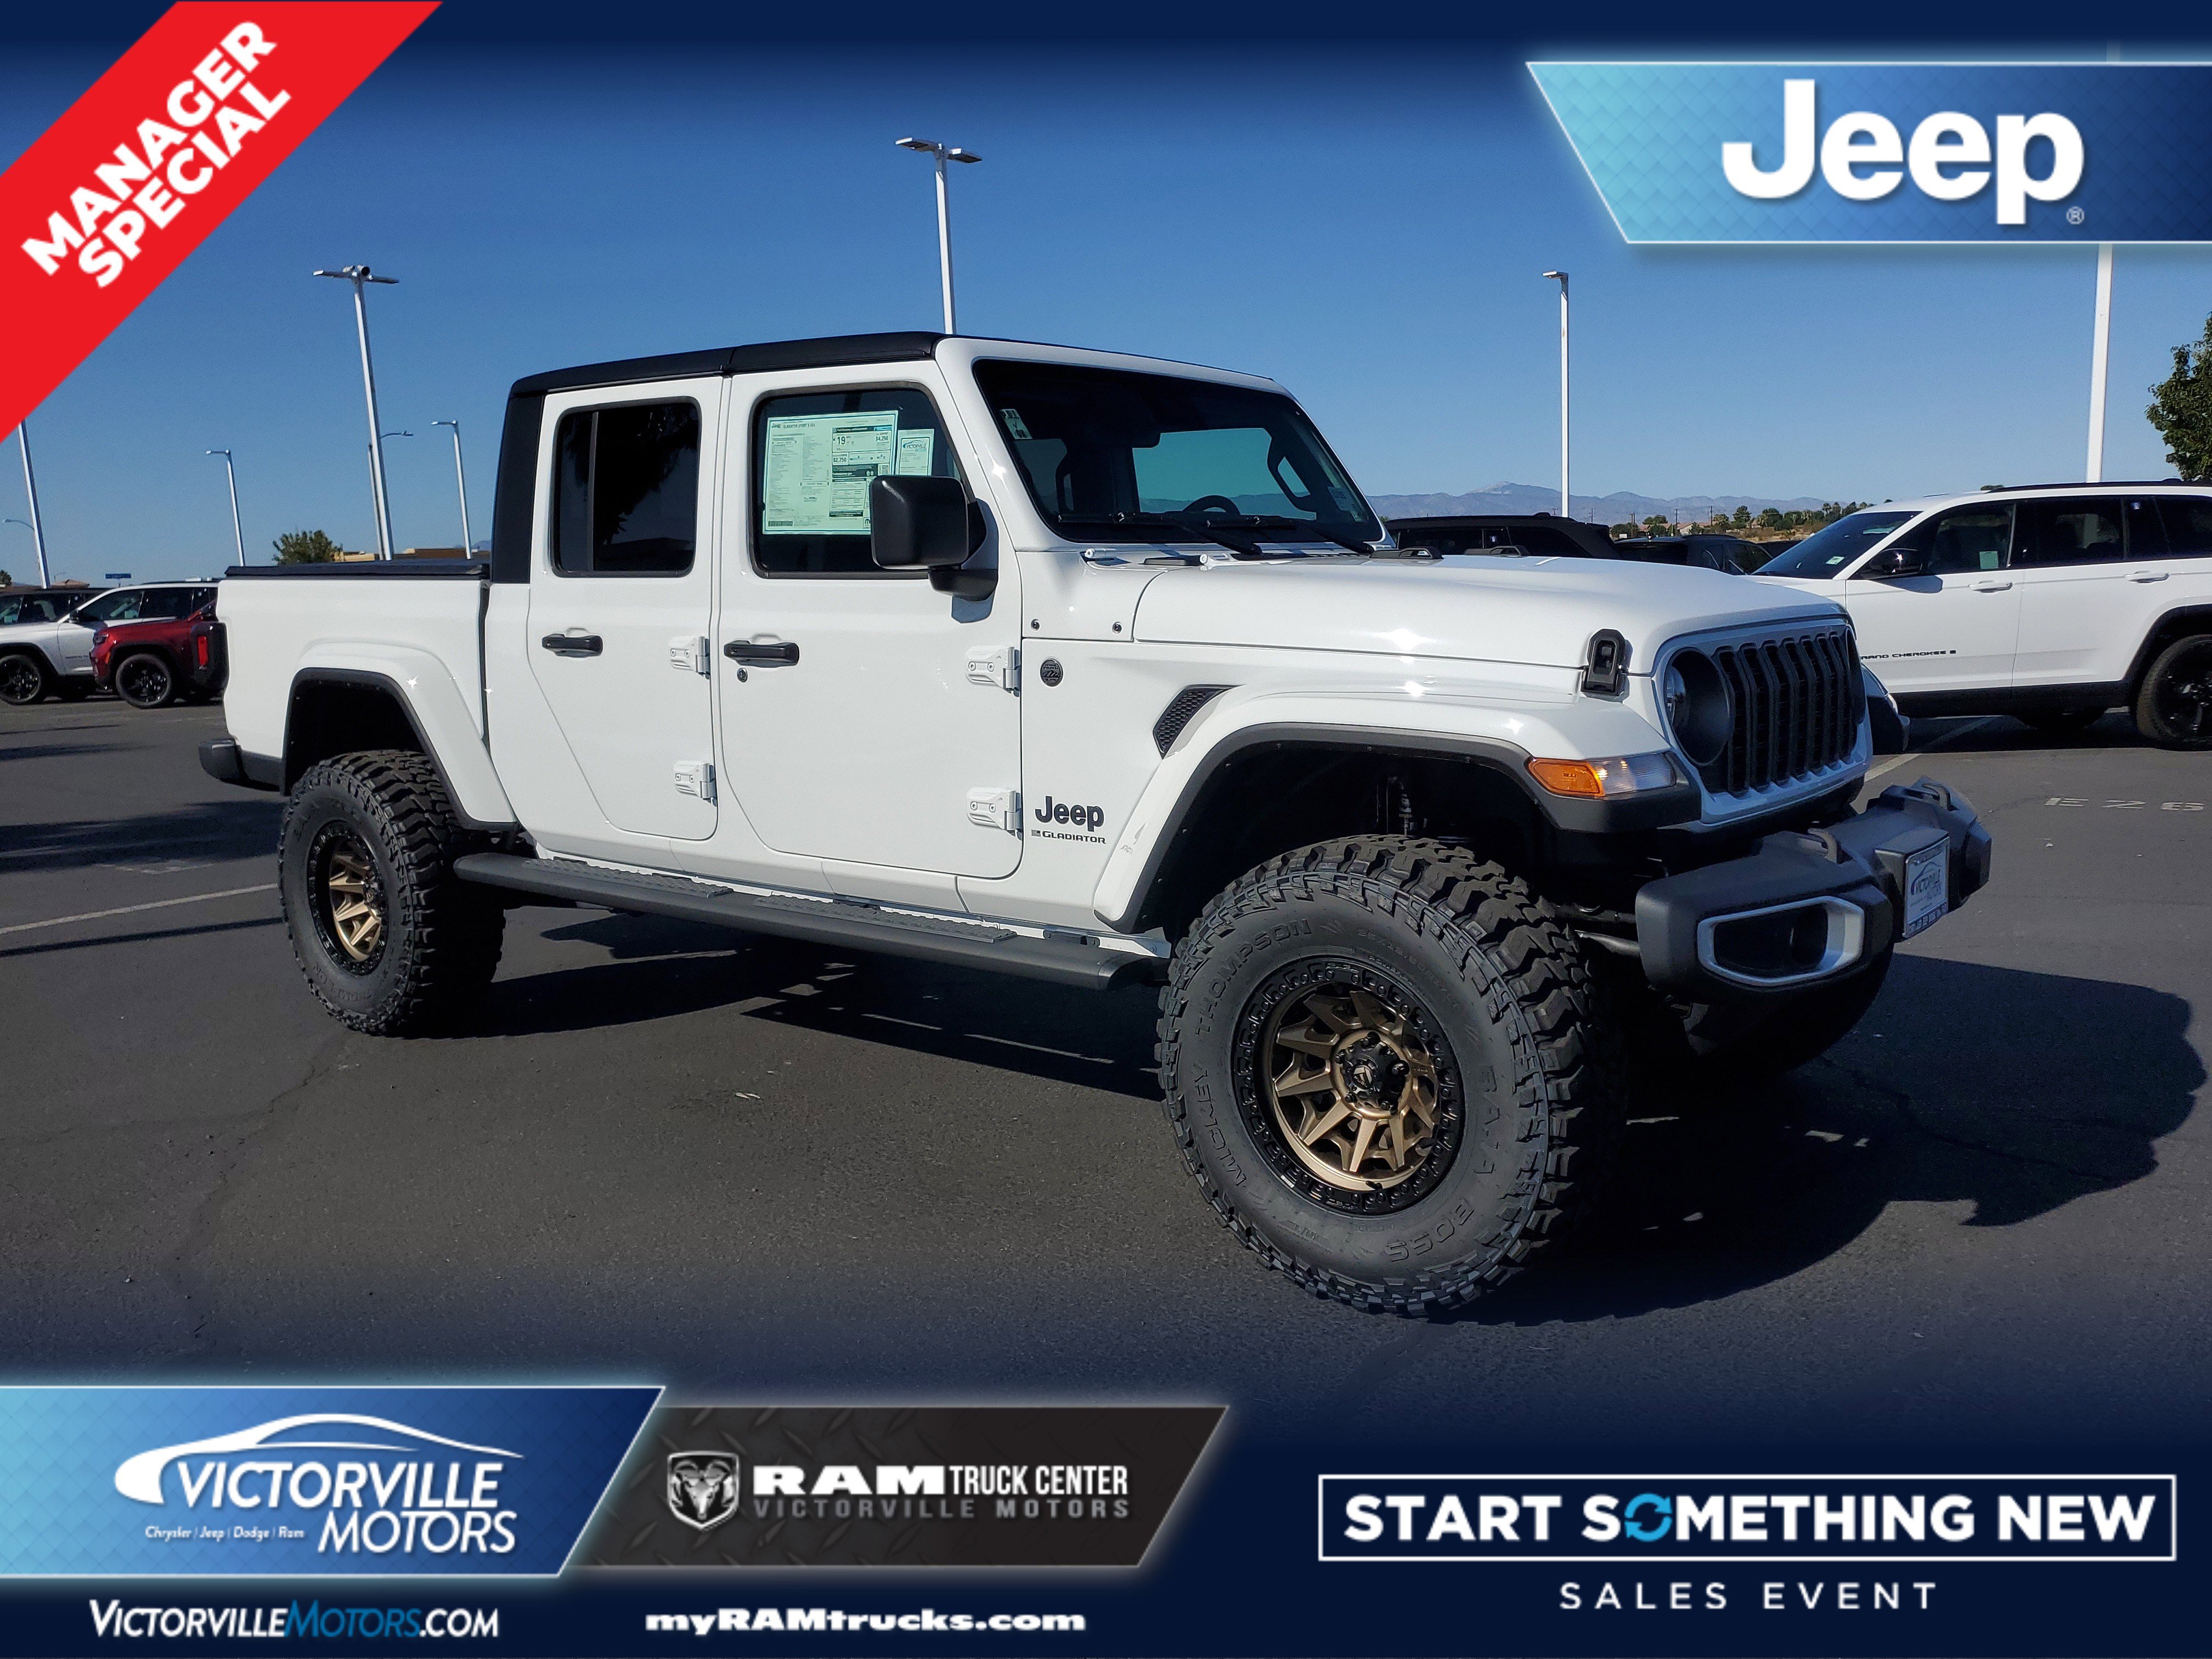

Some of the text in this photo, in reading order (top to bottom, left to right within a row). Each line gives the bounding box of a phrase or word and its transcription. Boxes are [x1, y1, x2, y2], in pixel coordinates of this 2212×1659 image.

[837, 436, 845, 445] 19
[1035, 796, 1104, 832] Jeep
[1042, 831, 1107, 844] GLADIATOR
[1194, 918, 1312, 1186] MICKEY THOMPSON
